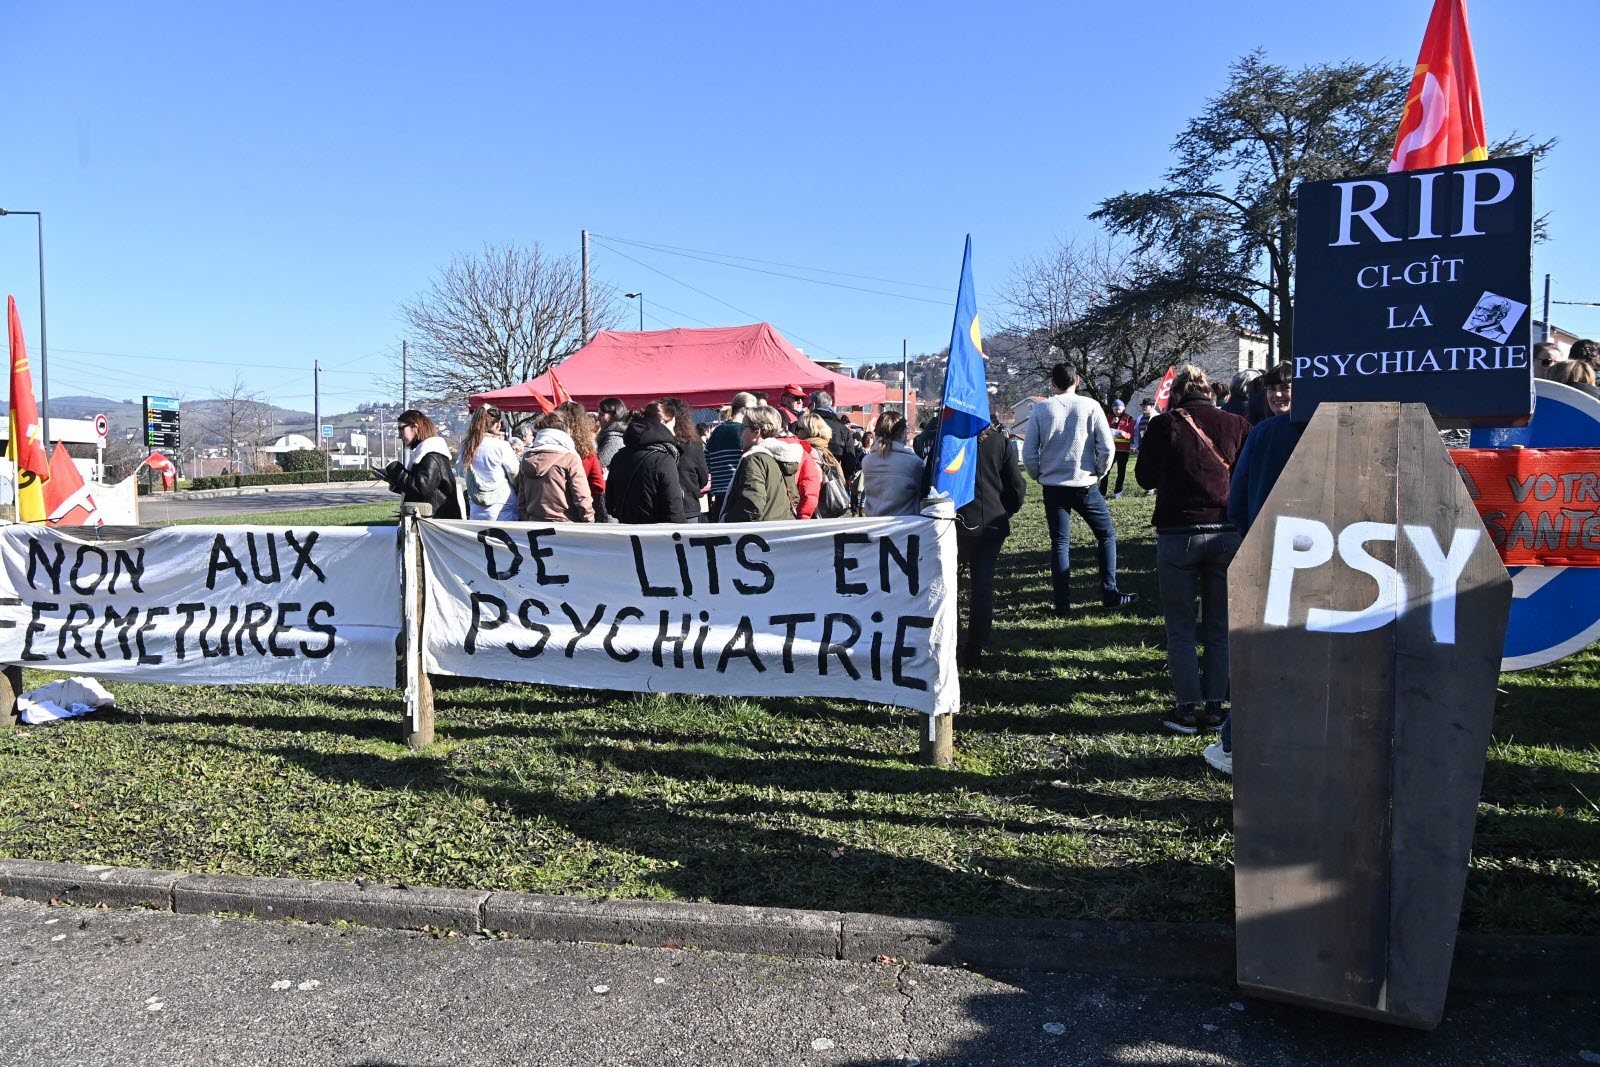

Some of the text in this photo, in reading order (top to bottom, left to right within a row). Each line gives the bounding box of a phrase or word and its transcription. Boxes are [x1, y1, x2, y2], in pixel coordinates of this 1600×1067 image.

[1328, 167, 1515, 247] RIP
[1356, 255, 1464, 289] CI-GÎT
[1386, 304, 1433, 329] LA
[1294, 345, 1528, 379] PSYCHIATRIE
[1507, 472, 1600, 503] VOTR
[26, 530, 326, 595] NON AUX
[477, 527, 570, 586] DE
[833, 532, 920, 596] EN
[1263, 515, 1481, 645] PSY
